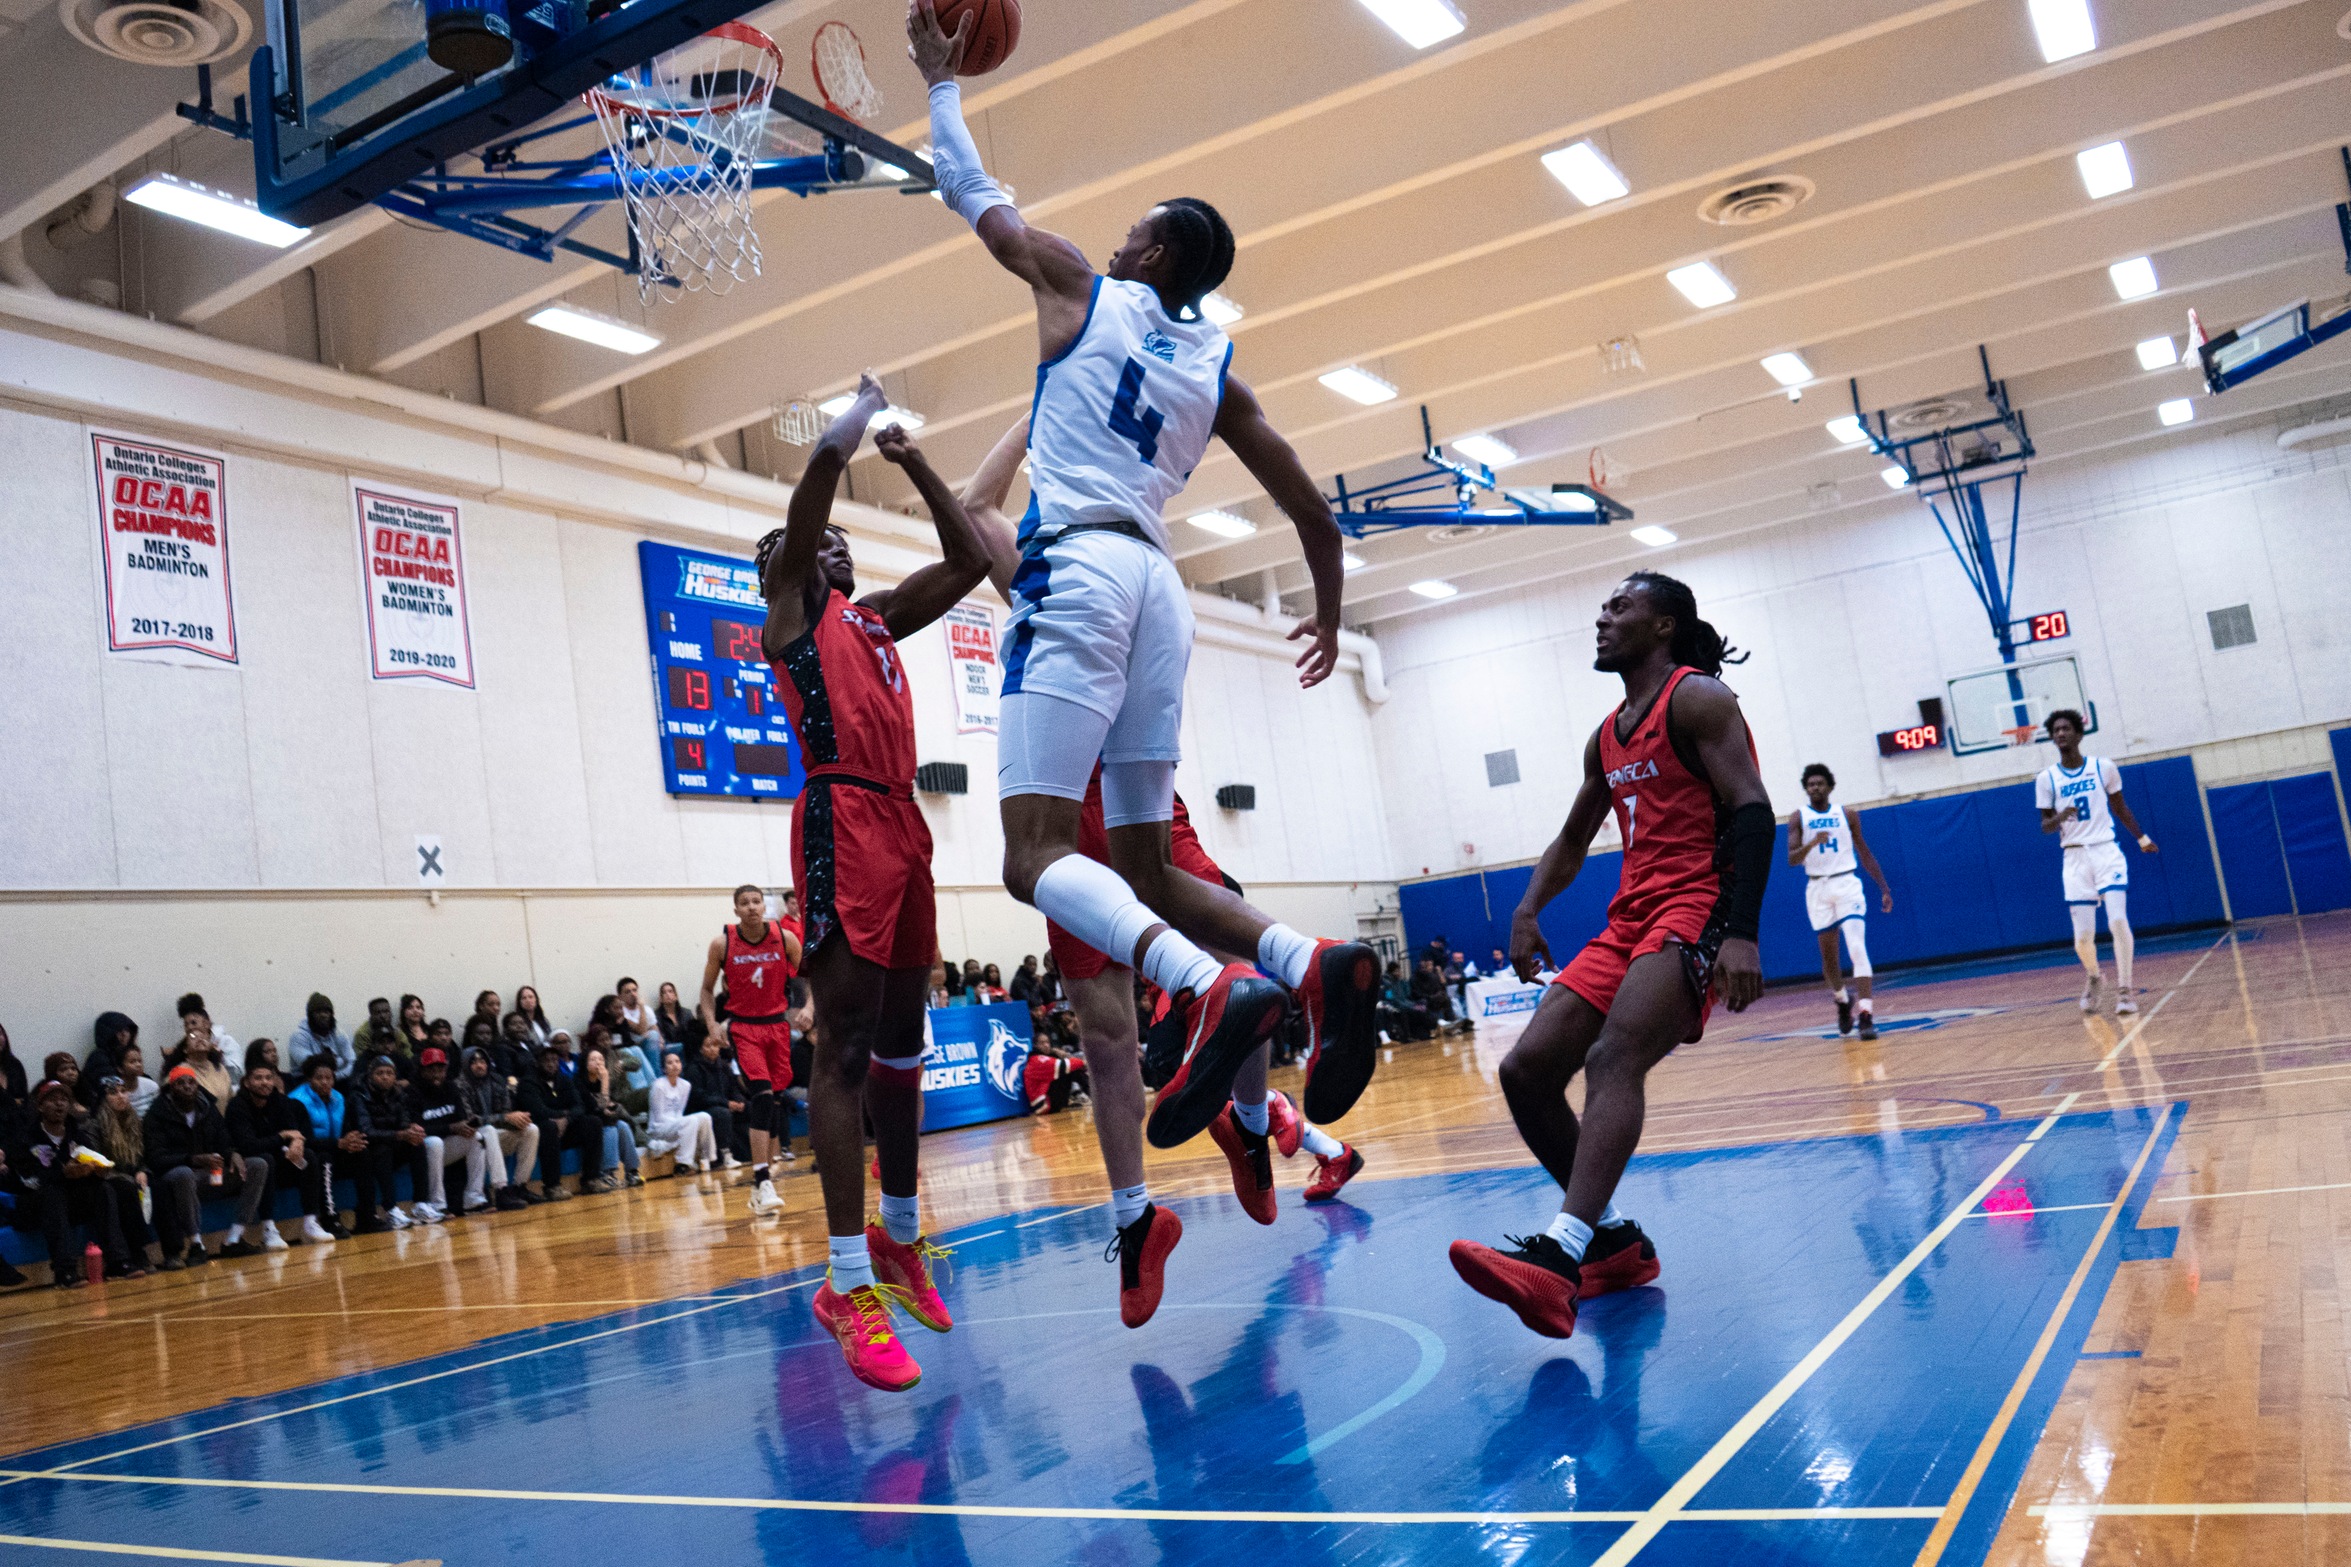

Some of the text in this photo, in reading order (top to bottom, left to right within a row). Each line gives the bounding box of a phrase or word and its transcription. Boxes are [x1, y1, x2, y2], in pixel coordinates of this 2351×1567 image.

[1108, 356, 1165, 469] 4
[113, 446, 206, 474] Ontario Colleges
[106, 458, 215, 489] Athletic Association
[113, 475, 212, 521] OCAA
[367, 511, 452, 536] Athletic Association
[373, 501, 444, 523] Ontario Colleges
[113, 508, 216, 547] CHAMPIONS
[144, 539, 191, 559] MEN'S
[375, 528, 450, 565] OCAA
[128, 552, 209, 578] BADMINTON
[373, 556, 455, 588] CHAMPIONS
[688, 561, 732, 580] GEORGE
[387, 580, 445, 601] WOMEN'S
[382, 595, 453, 617] BADMINTON
[132, 618, 213, 641] 2017-2018
[952, 624, 992, 648] OCAA
[2036, 612, 2067, 640] 20
[389, 648, 456, 669] 2019-2020
[669, 640, 703, 661] HOME
[953, 645, 995, 665] CHAMPIONS
[686, 671, 709, 710] 13
[753, 689, 760, 714] 1
[1895, 725, 1937, 749] 9:09
[688, 743, 702, 767] 4
[1622, 794, 1637, 848] 7
[751, 966, 764, 989] 4
